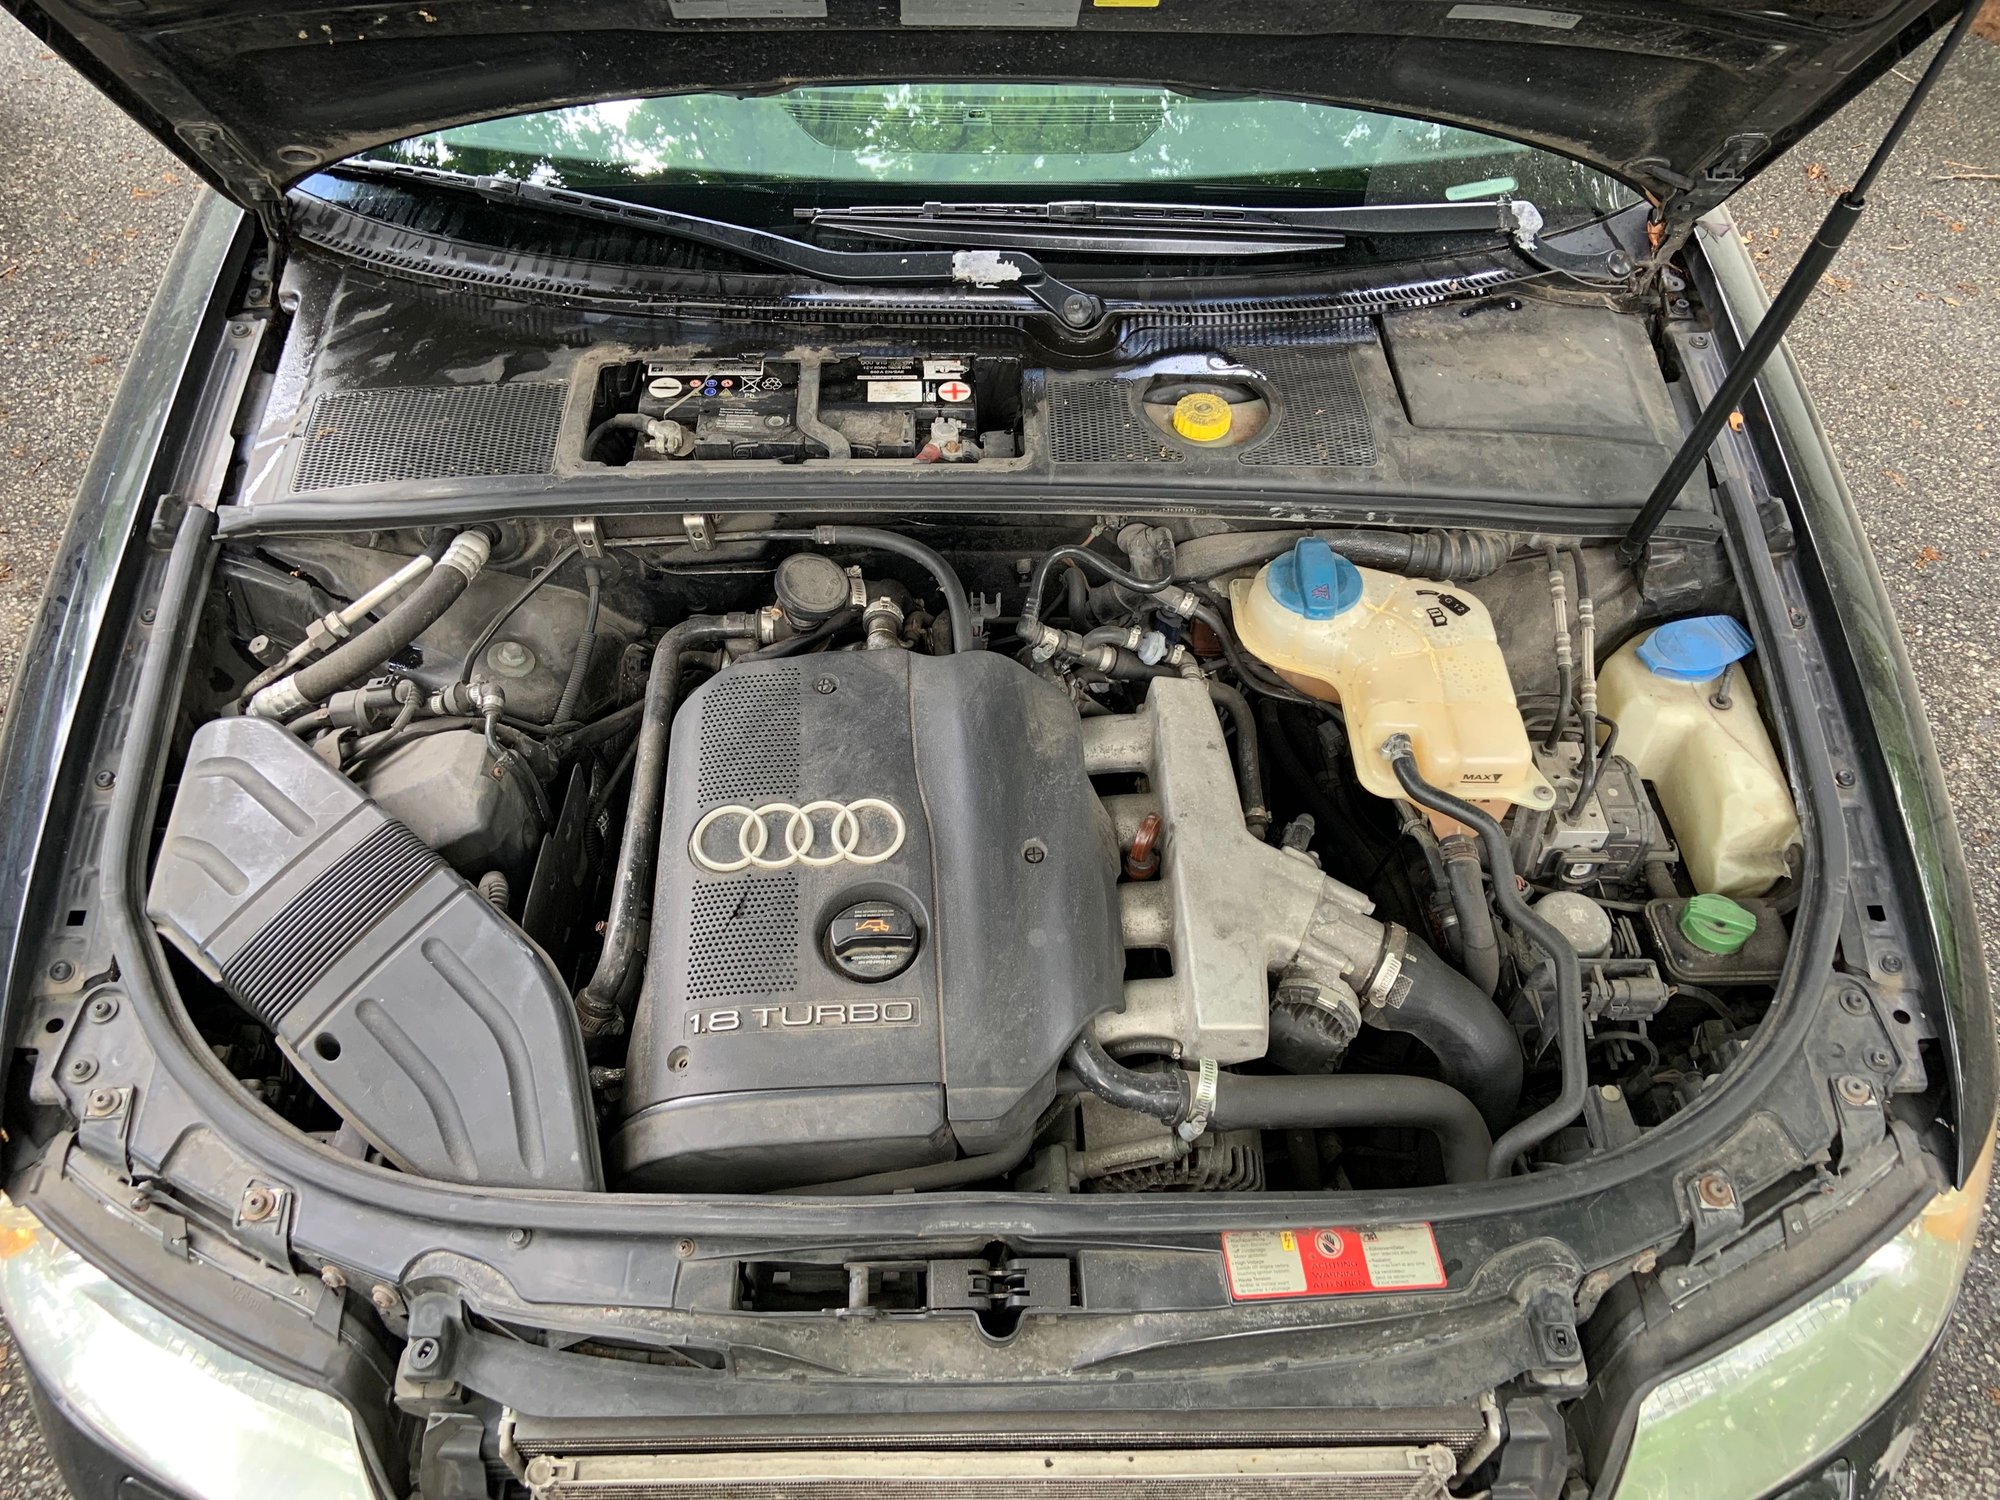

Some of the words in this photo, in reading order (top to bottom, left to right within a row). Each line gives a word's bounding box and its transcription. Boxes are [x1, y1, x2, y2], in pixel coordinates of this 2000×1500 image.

[1453, 603, 1465, 612] 12
[688, 1010, 741, 1034] 1.8
[752, 1001, 913, 1028] TURBO
[1311, 1261, 1358, 1270] ACHTUNG
[1311, 1270, 1361, 1278] WARNING
[1312, 1279, 1366, 1288] ATTENTION
